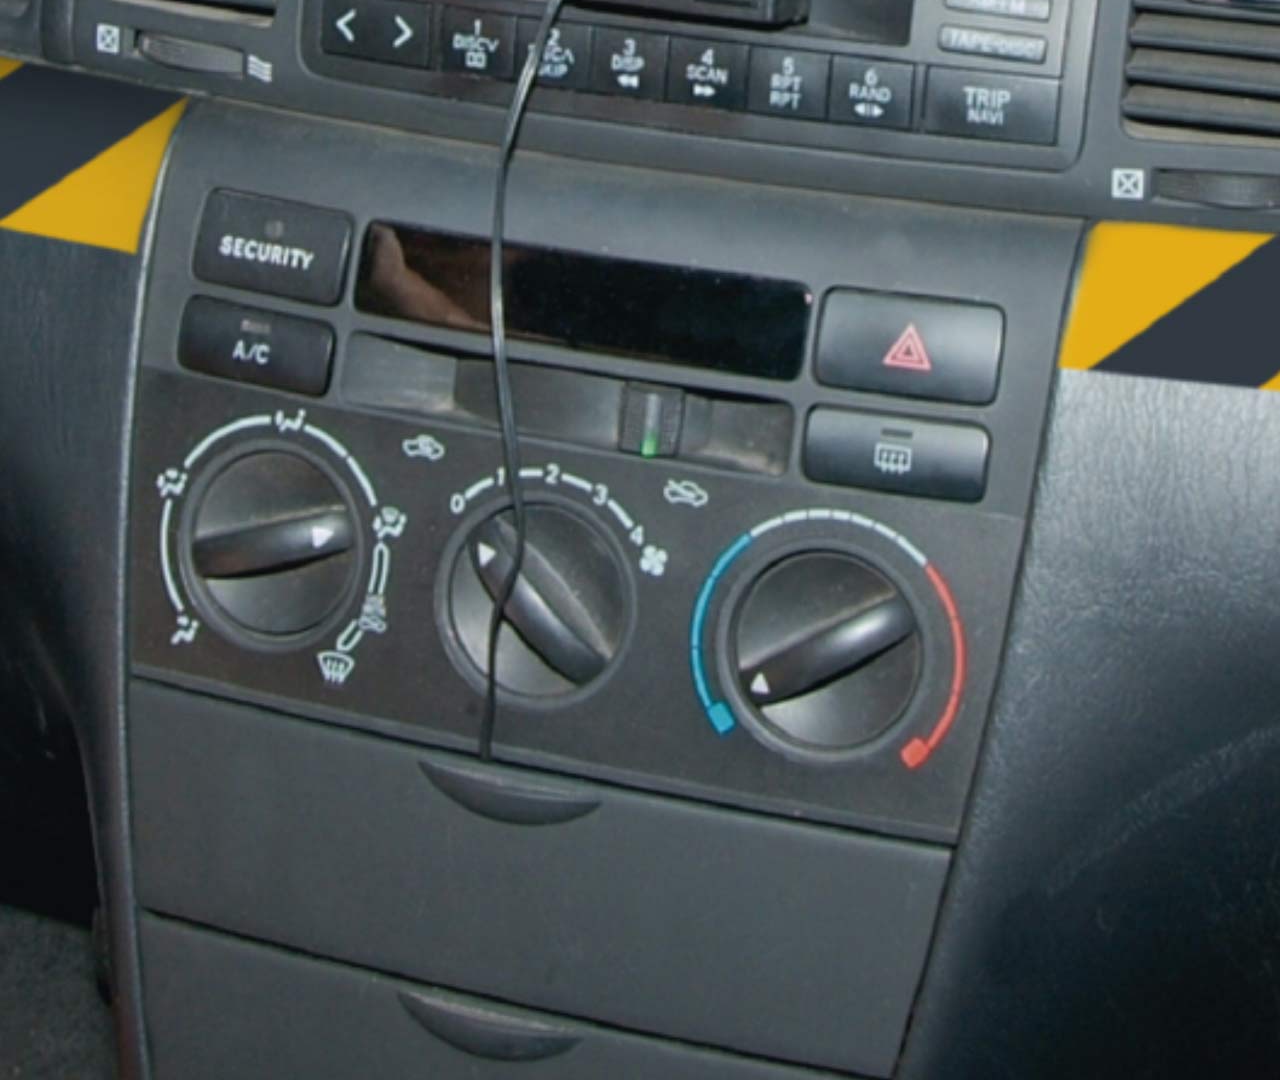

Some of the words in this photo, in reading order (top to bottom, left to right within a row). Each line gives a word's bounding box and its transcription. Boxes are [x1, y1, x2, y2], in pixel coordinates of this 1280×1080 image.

[547, 27, 561, 46] 2
[622, 38, 636, 56] 3
[701, 48, 714, 66] 4
[610, 53, 645, 71] DISP
[782, 56, 795, 75] 5
[686, 63, 728, 85] SCAN
[770, 72, 802, 92] RPT
[864, 68, 878, 87] 6
[769, 90, 802, 110] RPT
[848, 82, 892, 104] RAND
[962, 85, 1011, 110] TRIP
[966, 108, 1004, 126] NAVI
[219, 233, 315, 271] SECURITY
[232, 339, 271, 365] A/C
[449, 493, 465, 514] 0
[496, 467, 505, 486] 1
[545, 463, 560, 485] 2
[593, 483, 608, 506] 3
[629, 524, 644, 546] 4
